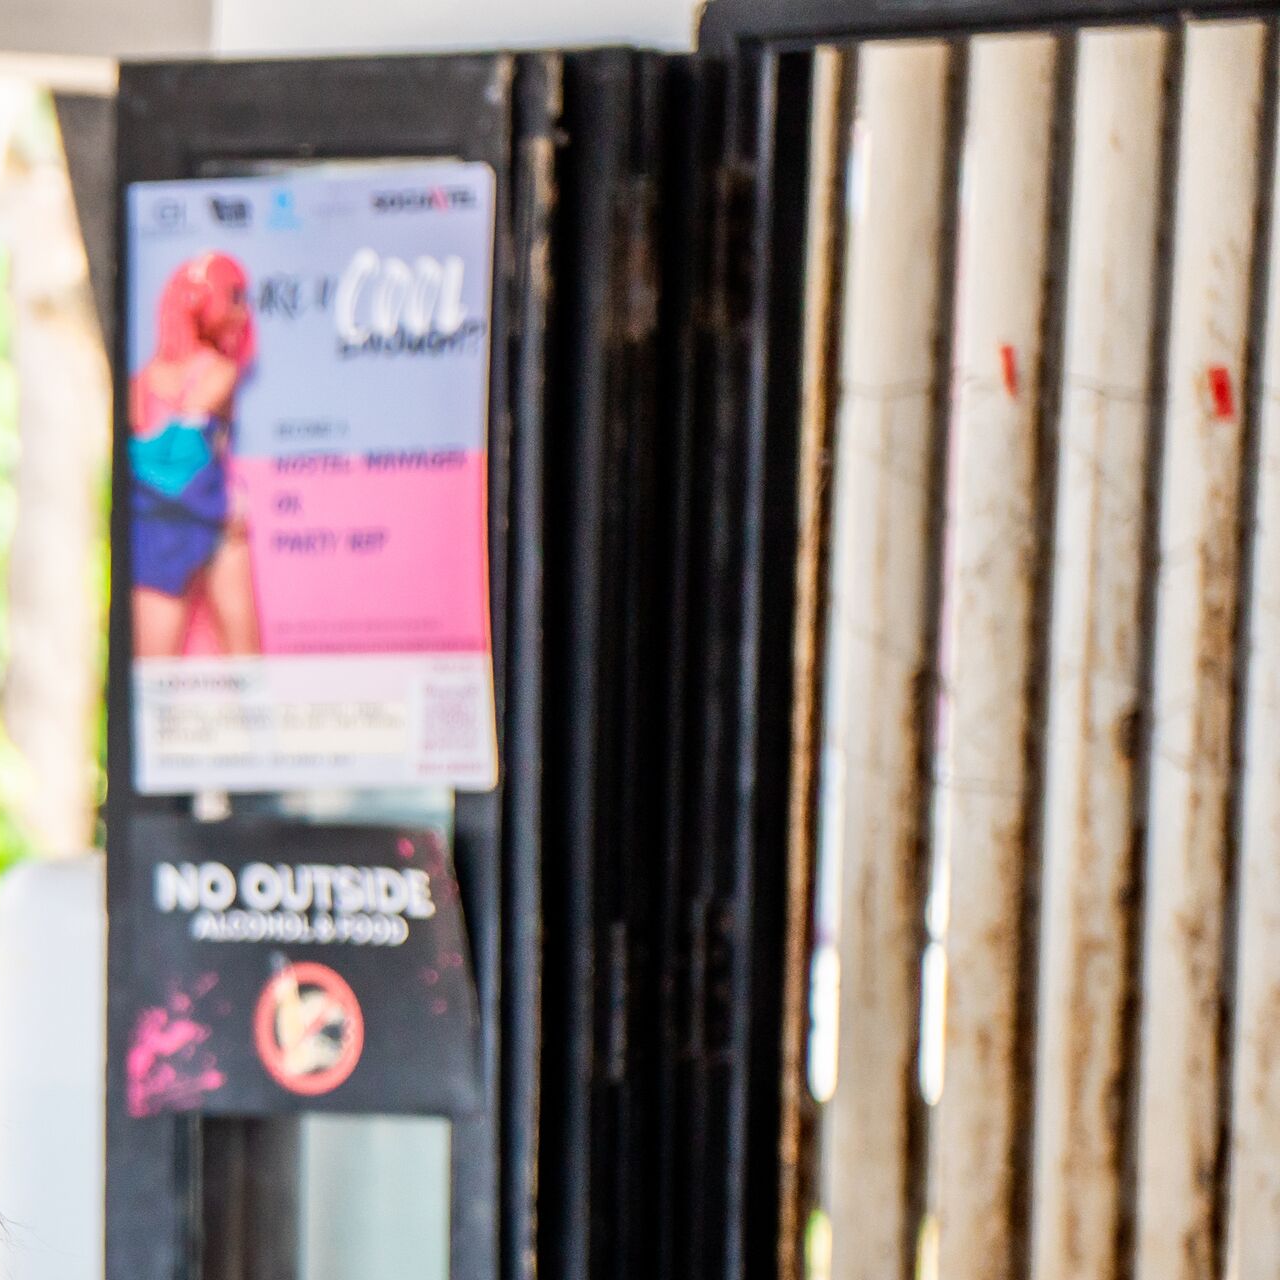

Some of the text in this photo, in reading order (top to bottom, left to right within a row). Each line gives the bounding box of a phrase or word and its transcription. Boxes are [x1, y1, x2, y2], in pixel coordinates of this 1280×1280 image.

[336, 247, 467, 347] COOL
[155, 861, 436, 918] NO OUTSIDE
[193, 909, 313, 943] ALCOHOL
[336, 911, 409, 946] FOOD
